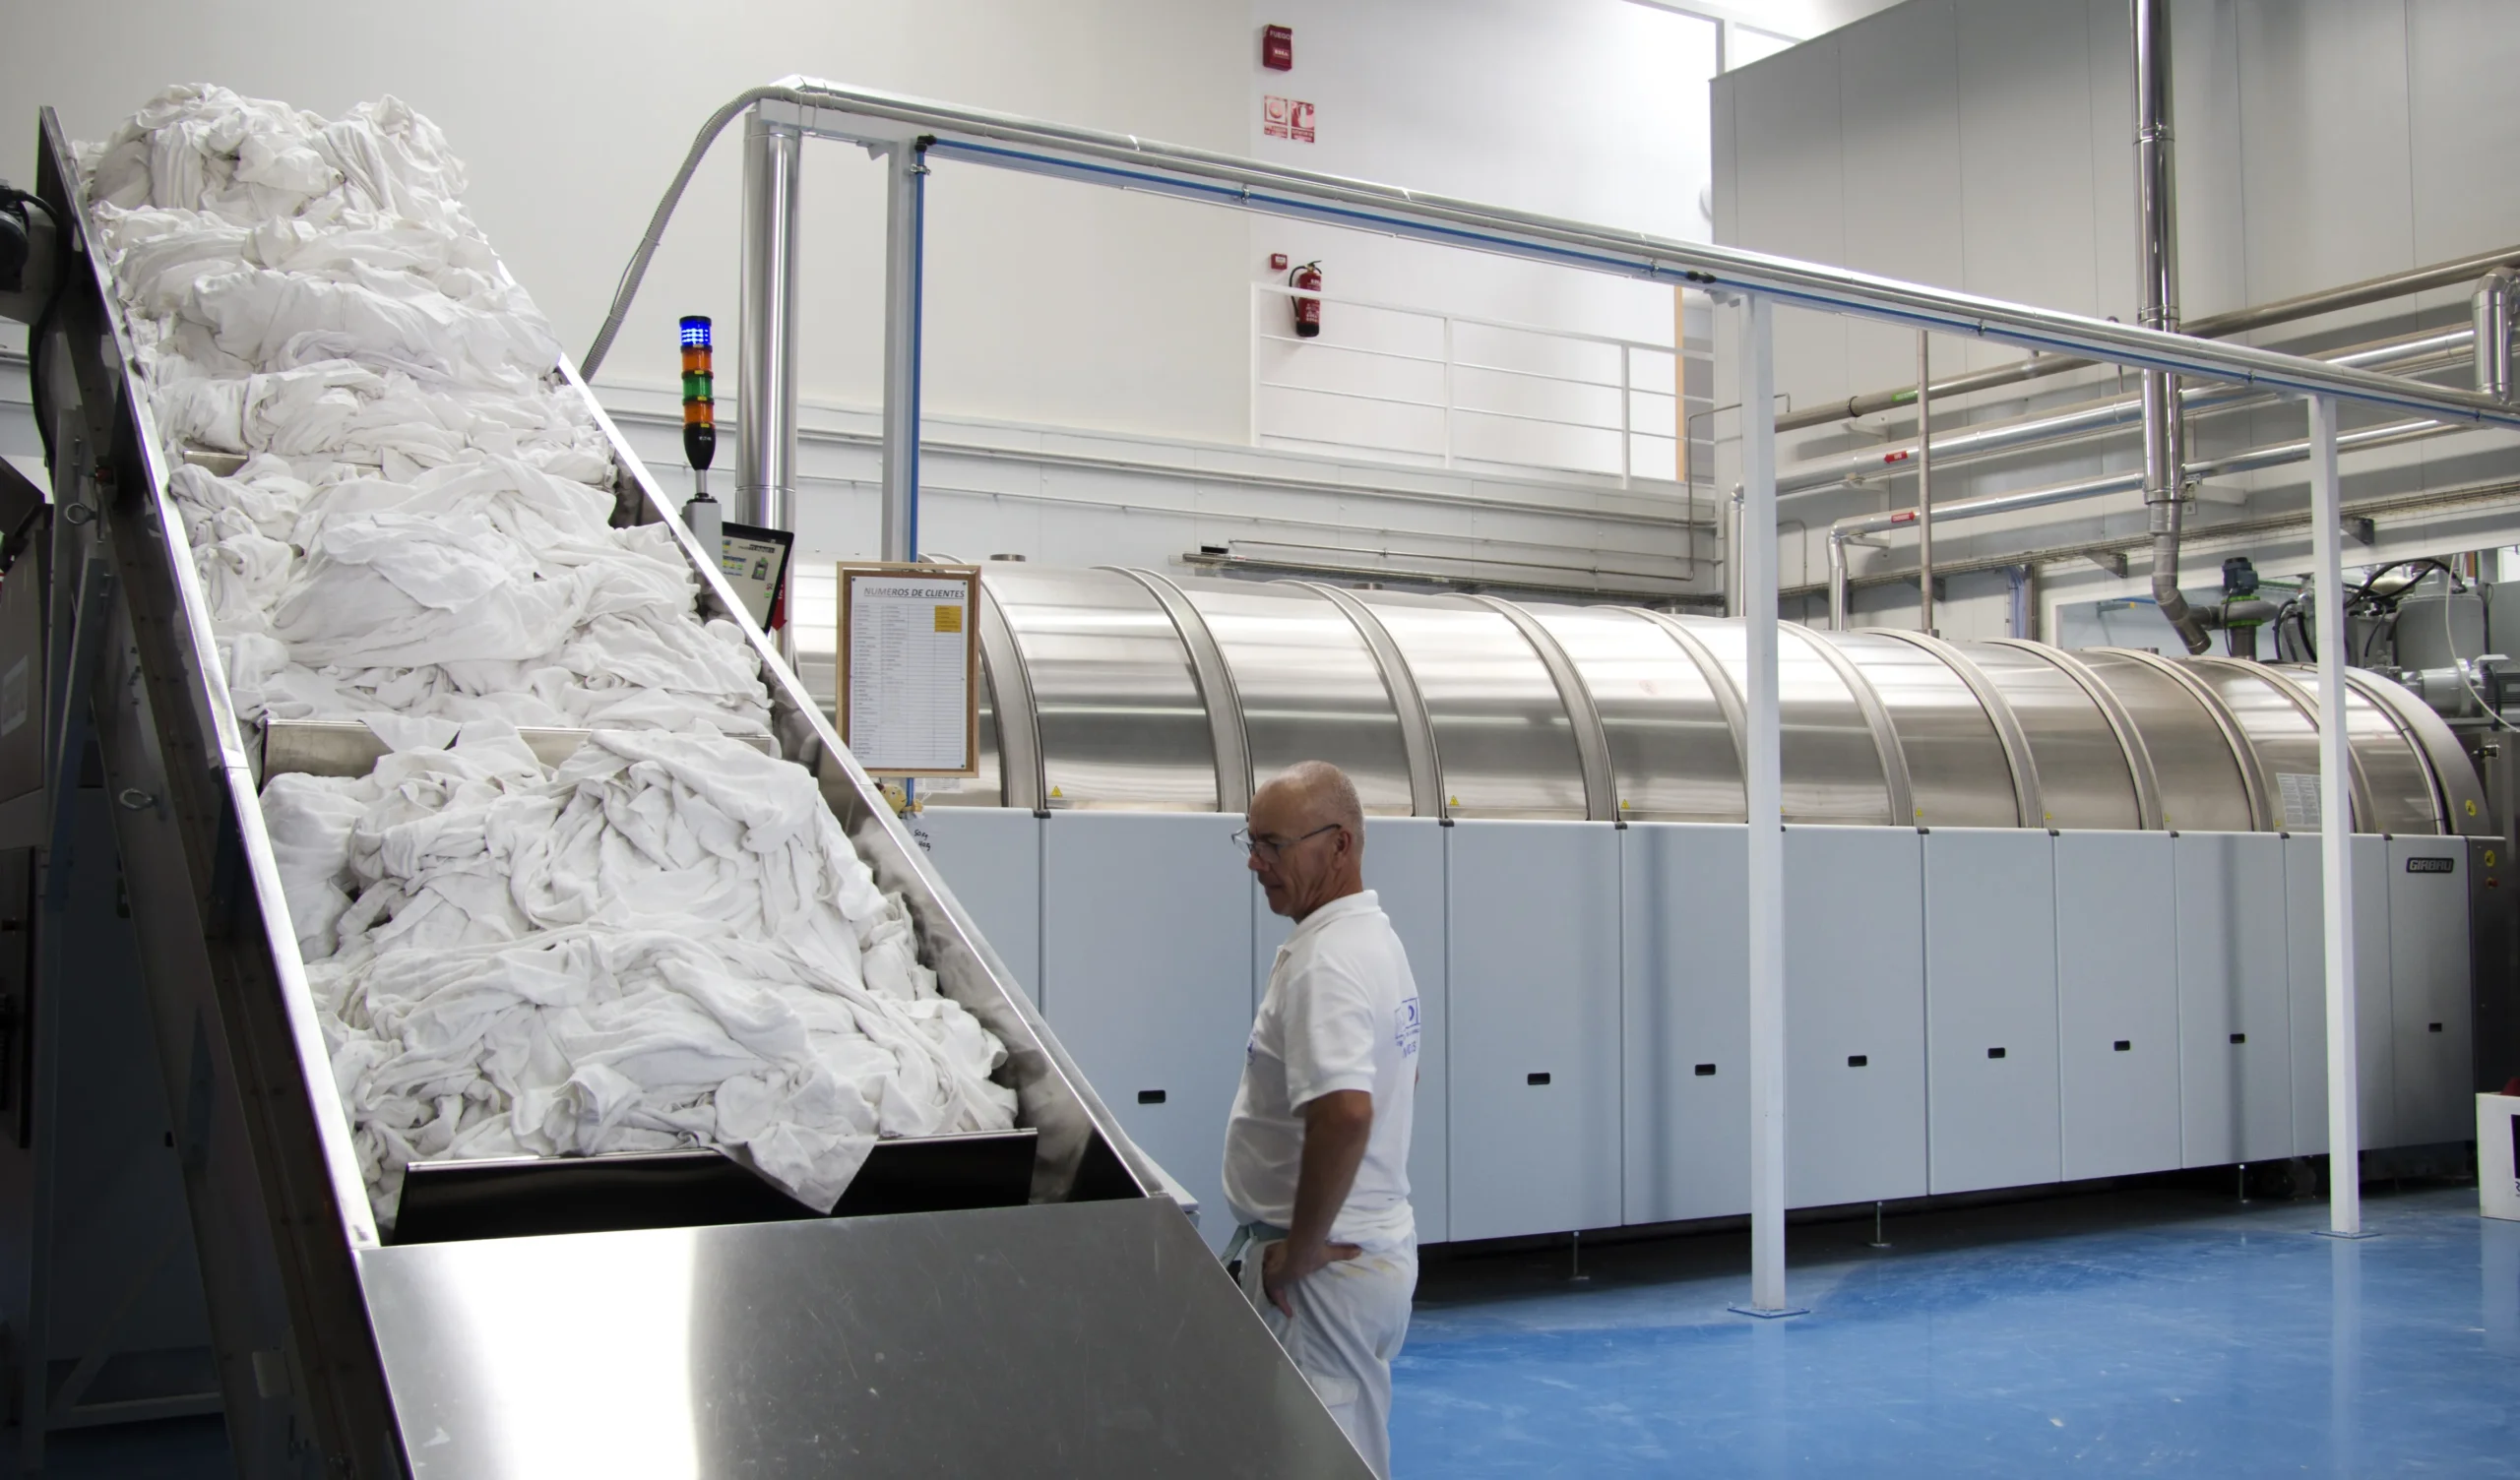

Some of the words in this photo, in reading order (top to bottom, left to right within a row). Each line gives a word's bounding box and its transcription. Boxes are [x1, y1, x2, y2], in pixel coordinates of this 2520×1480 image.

[1270, 30, 1291, 40] FUEGO
[863, 586, 910, 597] NUMEROS
[911, 588, 924, 597] DE
[925, 588, 965, 598] CLIENTES
[2409, 859, 2453, 871] GIRBAU
